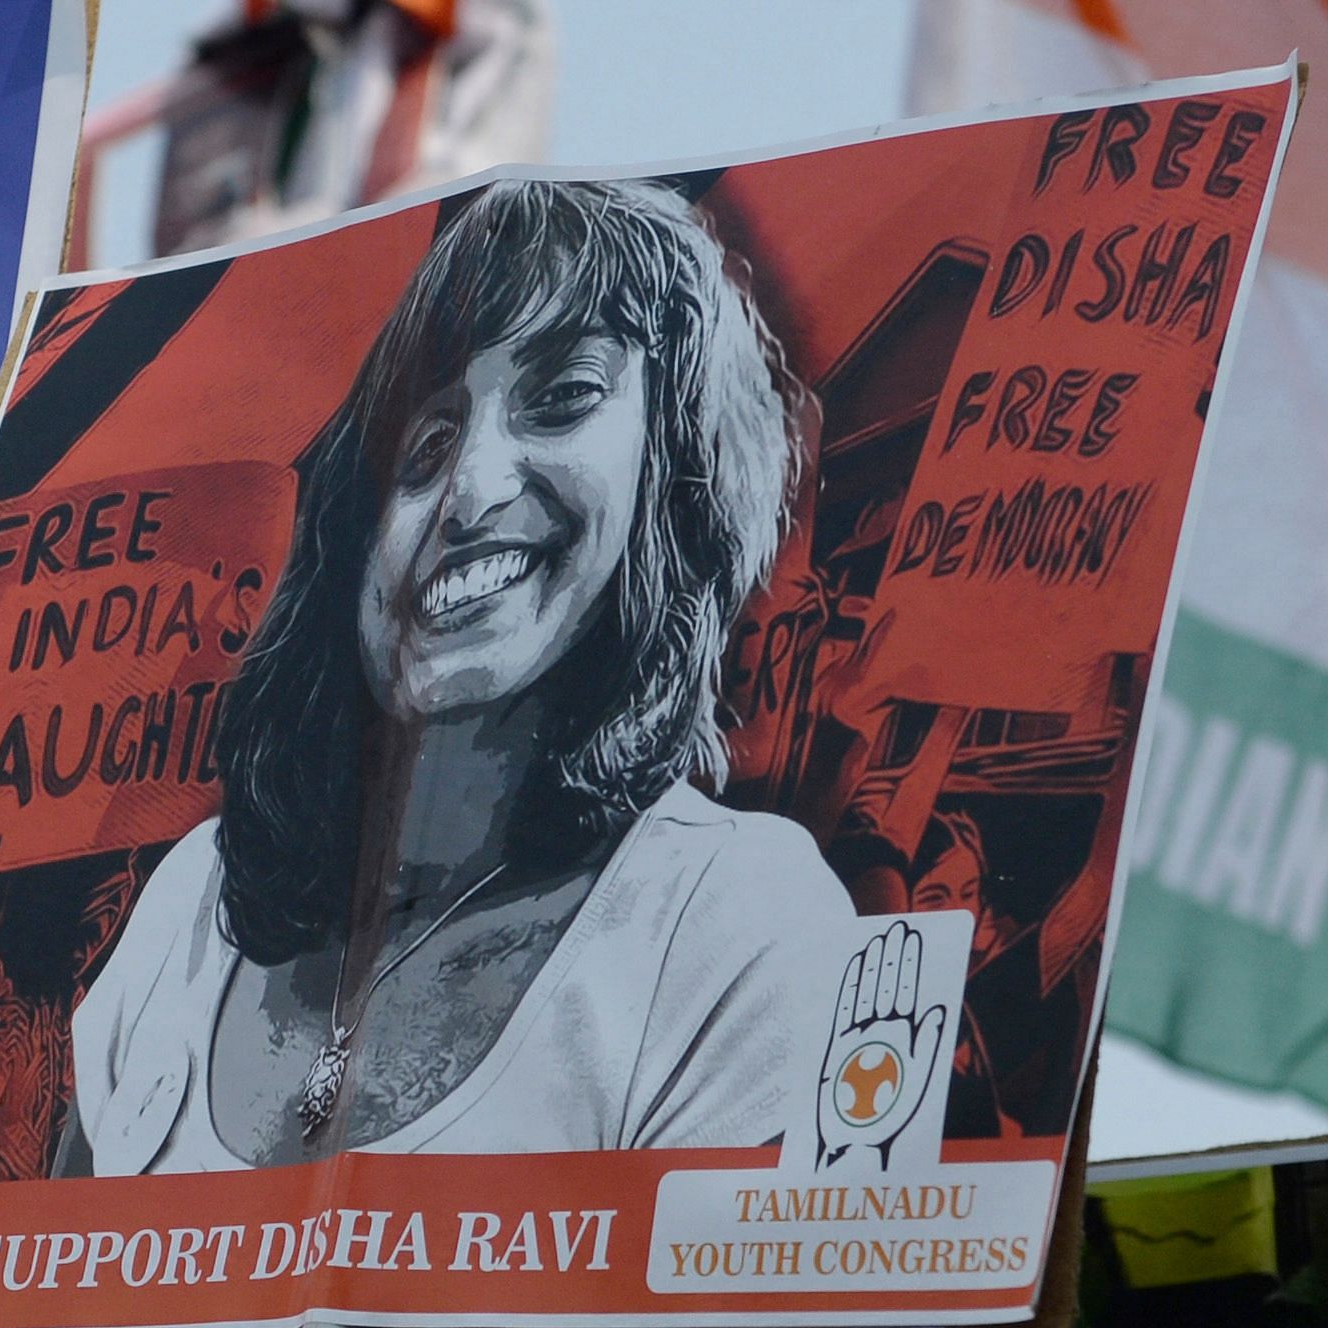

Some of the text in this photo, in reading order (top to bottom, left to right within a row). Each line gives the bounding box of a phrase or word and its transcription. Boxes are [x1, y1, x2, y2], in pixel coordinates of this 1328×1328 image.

[1034, 98, 1267, 203] FREE
[985, 217, 1231, 344] DISHA
[942, 363, 1140, 460] FREE
[8, 560, 264, 673] INDIA'S
[250, 1210, 431, 1282] DISHA
[447, 1209, 618, 1272] RAVI
[734, 1184, 977, 1223] TAMILNADU
[669, 1236, 1029, 1278] YOUTH CONGRESS
